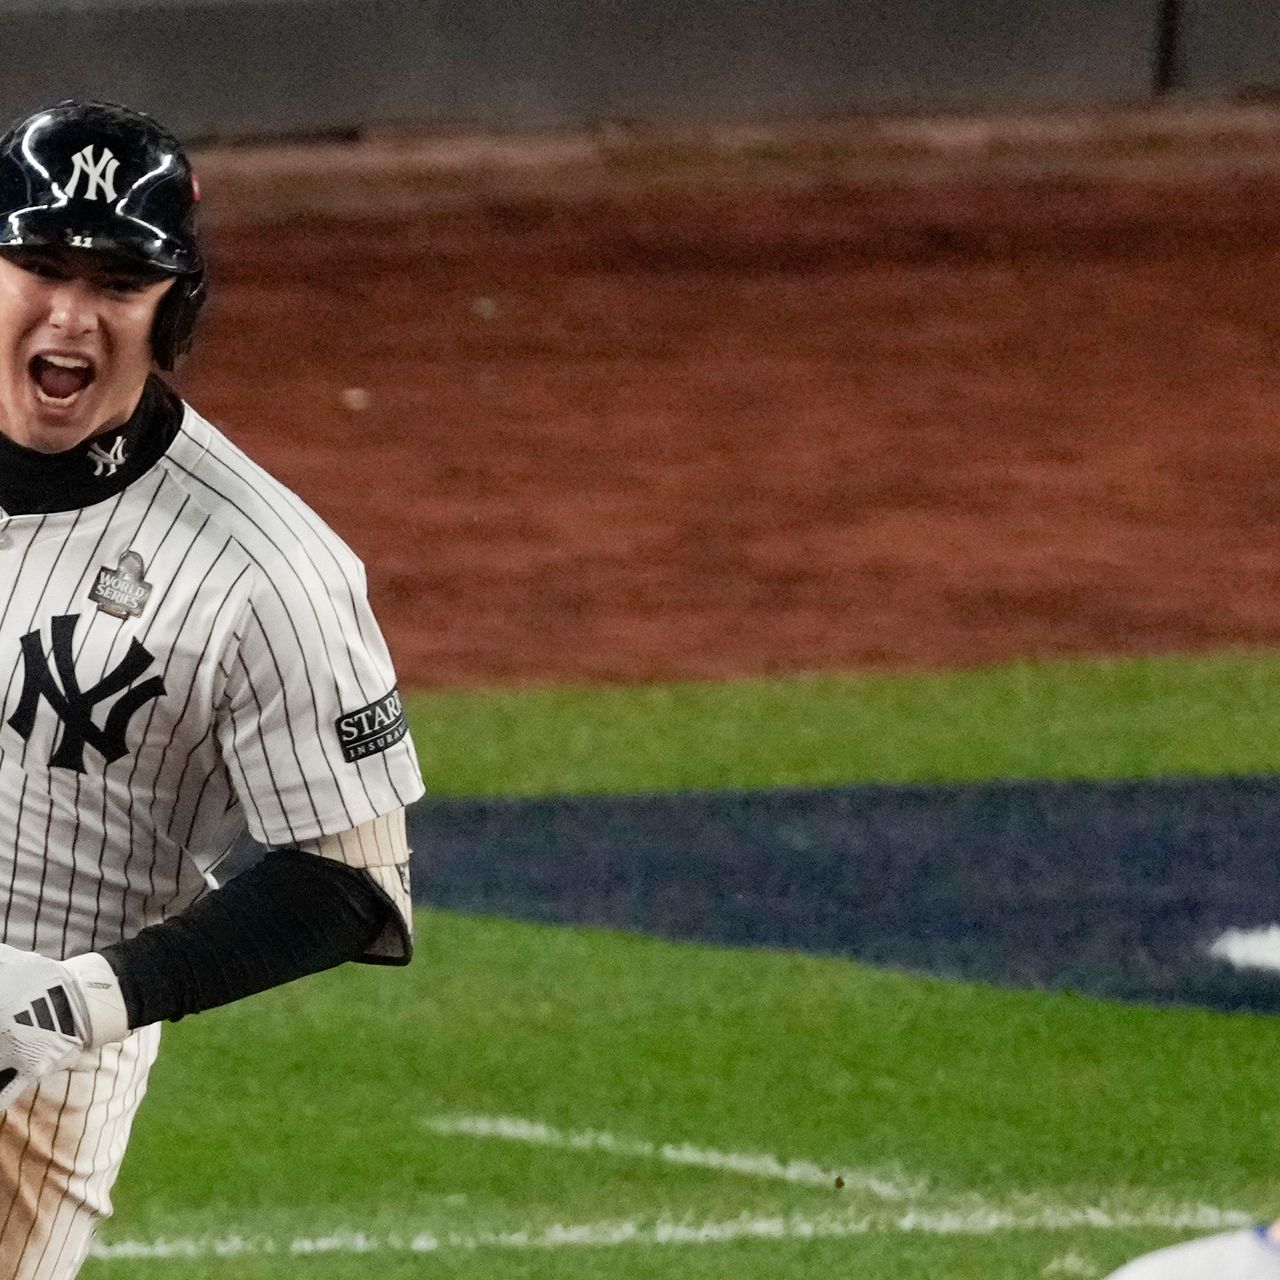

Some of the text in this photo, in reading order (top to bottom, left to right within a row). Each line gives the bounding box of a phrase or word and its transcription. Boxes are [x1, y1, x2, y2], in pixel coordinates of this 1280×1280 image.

[65, 143, 121, 204] NY
[87, 435, 128, 477] NY
[95, 584, 139, 609] SERIES
[99, 571, 145, 597] WORLD
[7, 613, 168, 774] NY
